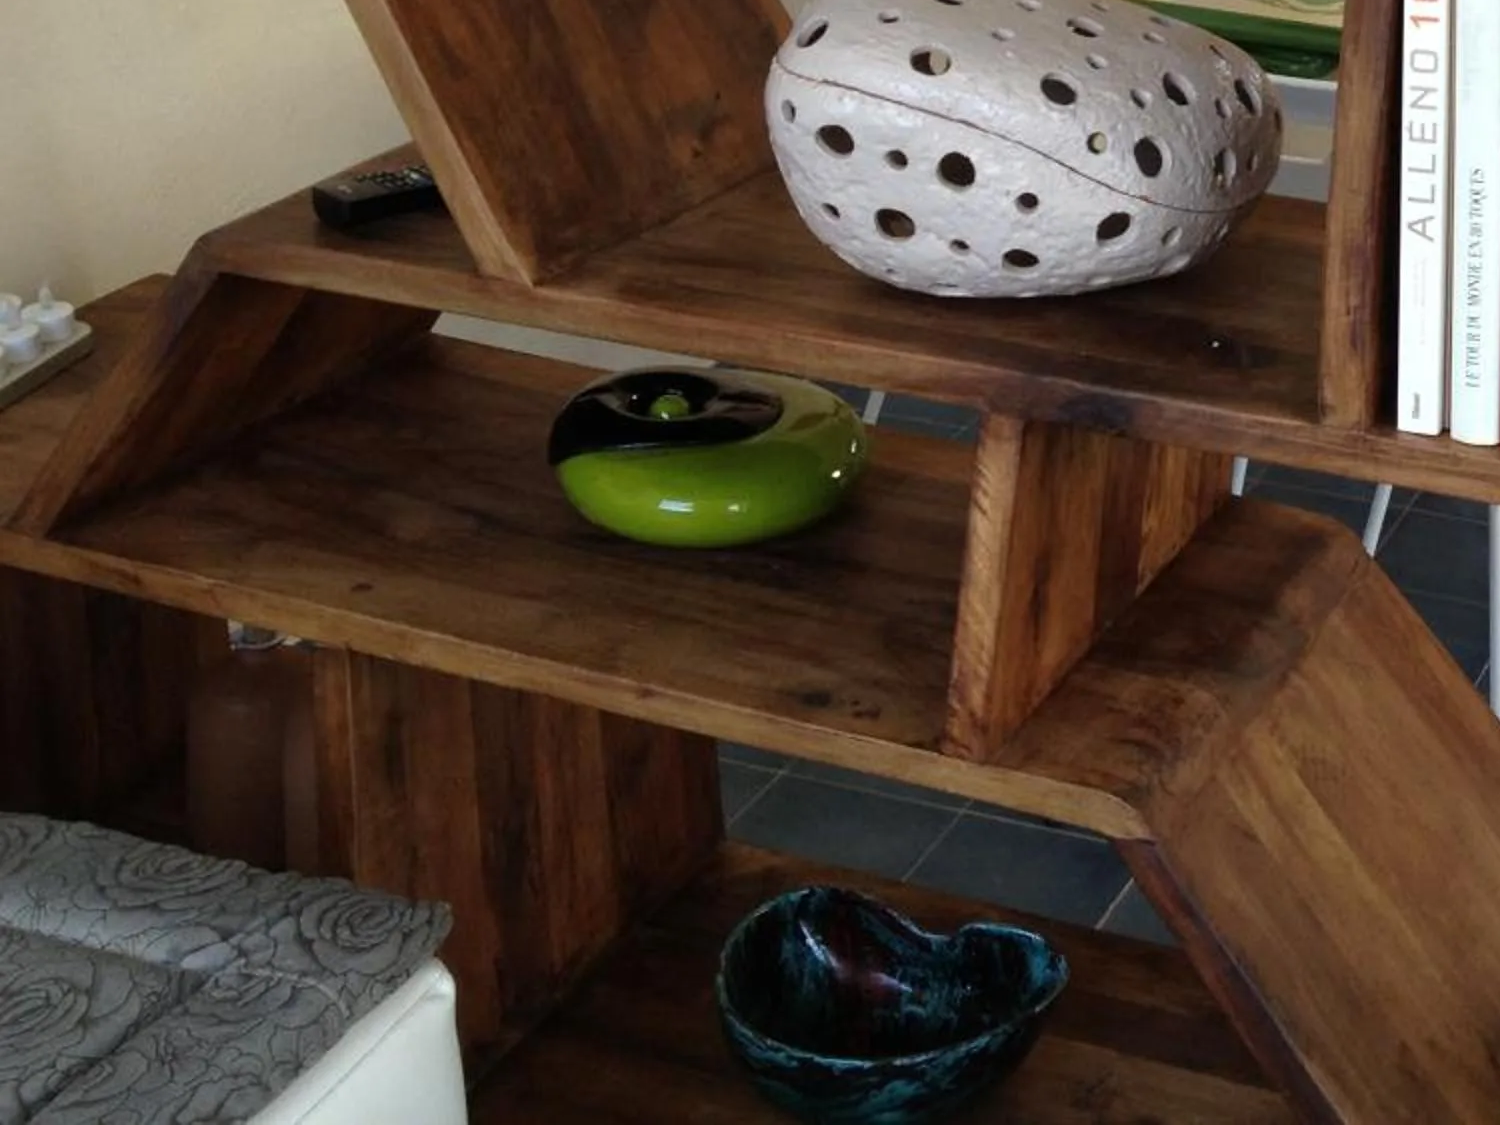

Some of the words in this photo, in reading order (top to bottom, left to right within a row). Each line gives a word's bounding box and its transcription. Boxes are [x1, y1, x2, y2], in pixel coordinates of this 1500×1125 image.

[1407, 48, 1441, 243] ALLÉNO
[1469, 168, 1487, 219] TOQUES
[1468, 239, 1484, 259] EN
[1467, 263, 1483, 307] MONDE
